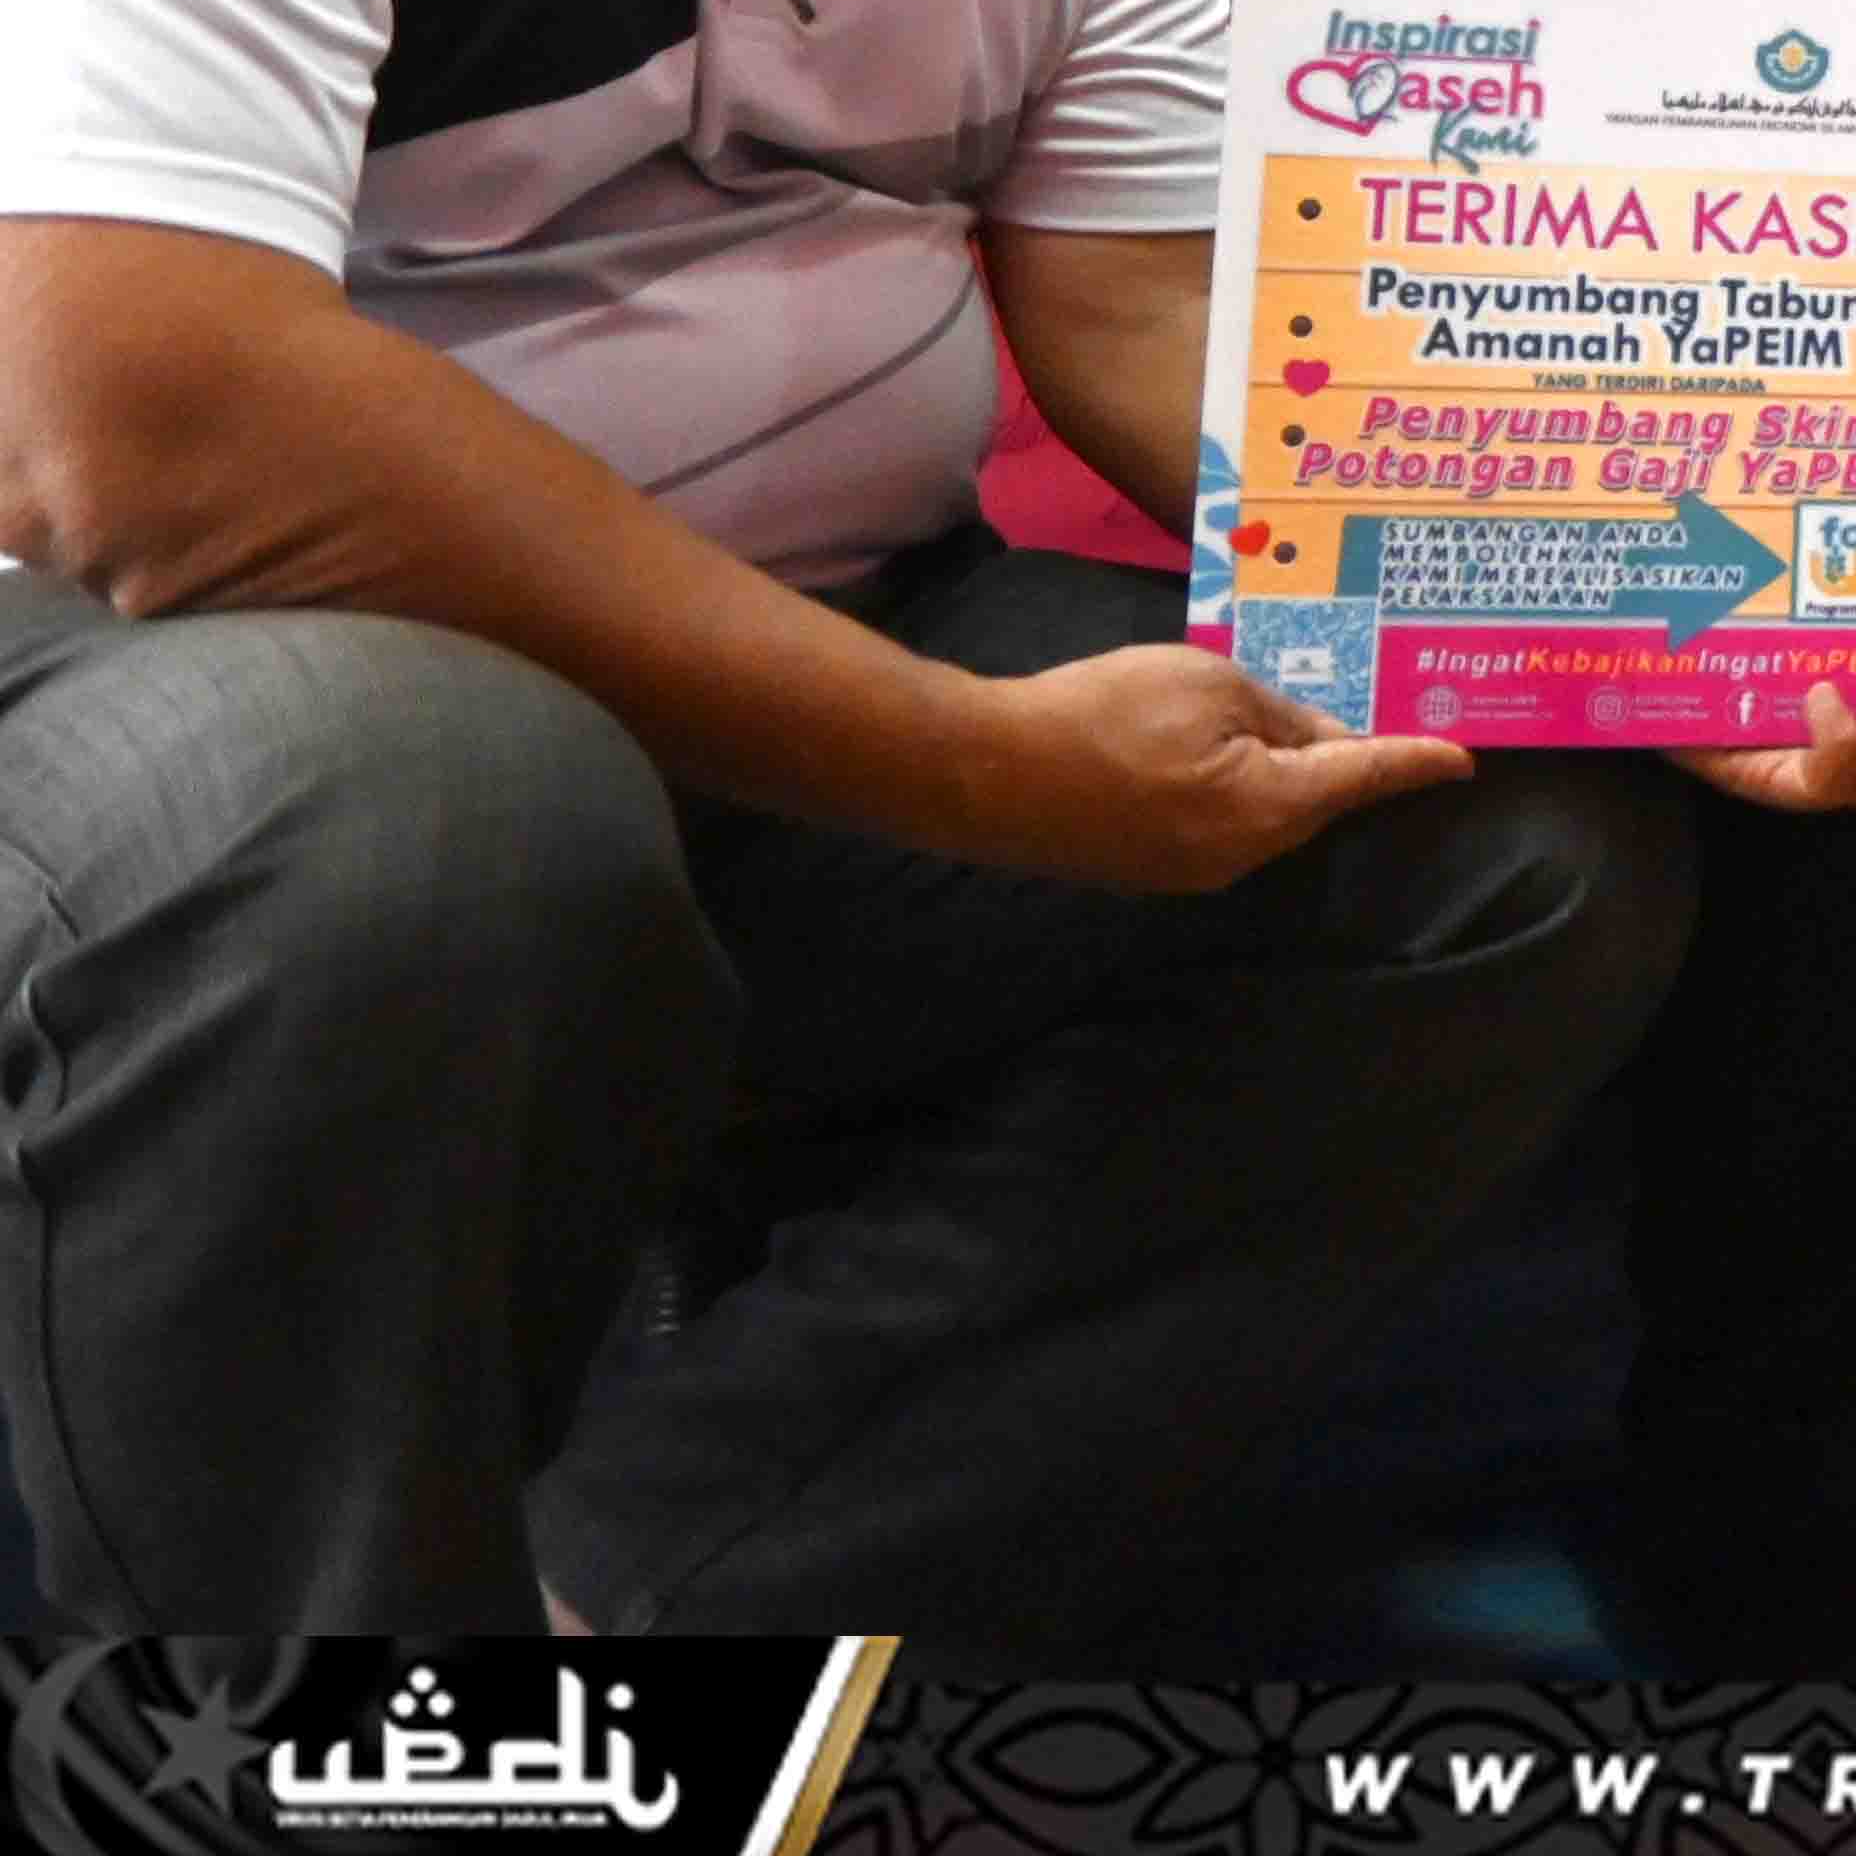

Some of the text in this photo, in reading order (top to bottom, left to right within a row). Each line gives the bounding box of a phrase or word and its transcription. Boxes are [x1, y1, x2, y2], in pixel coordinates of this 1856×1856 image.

[1326, 10, 1541, 58] Inspirasi
[1360, 178, 1659, 252] TERIMA
[1367, 267, 1700, 330] Penyumbang
[1421, 318, 1843, 368] Amanah YaPEIM
[1532, 372, 1766, 393] YANG TERDIRI DARIPADA
[1358, 396, 1734, 455] Penyumbang
[1293, 442, 1575, 498] Potongan
[1599, 446, 1714, 502] Gaji
[1383, 545, 1622, 564] MEMBOLEHKAN
[1385, 521, 1686, 545] SUMBANGAN ANDA
[1380, 588, 1611, 609] PELAKSANAAN
[1383, 565, 1744, 588] KAMI MEREALISASIKAN
